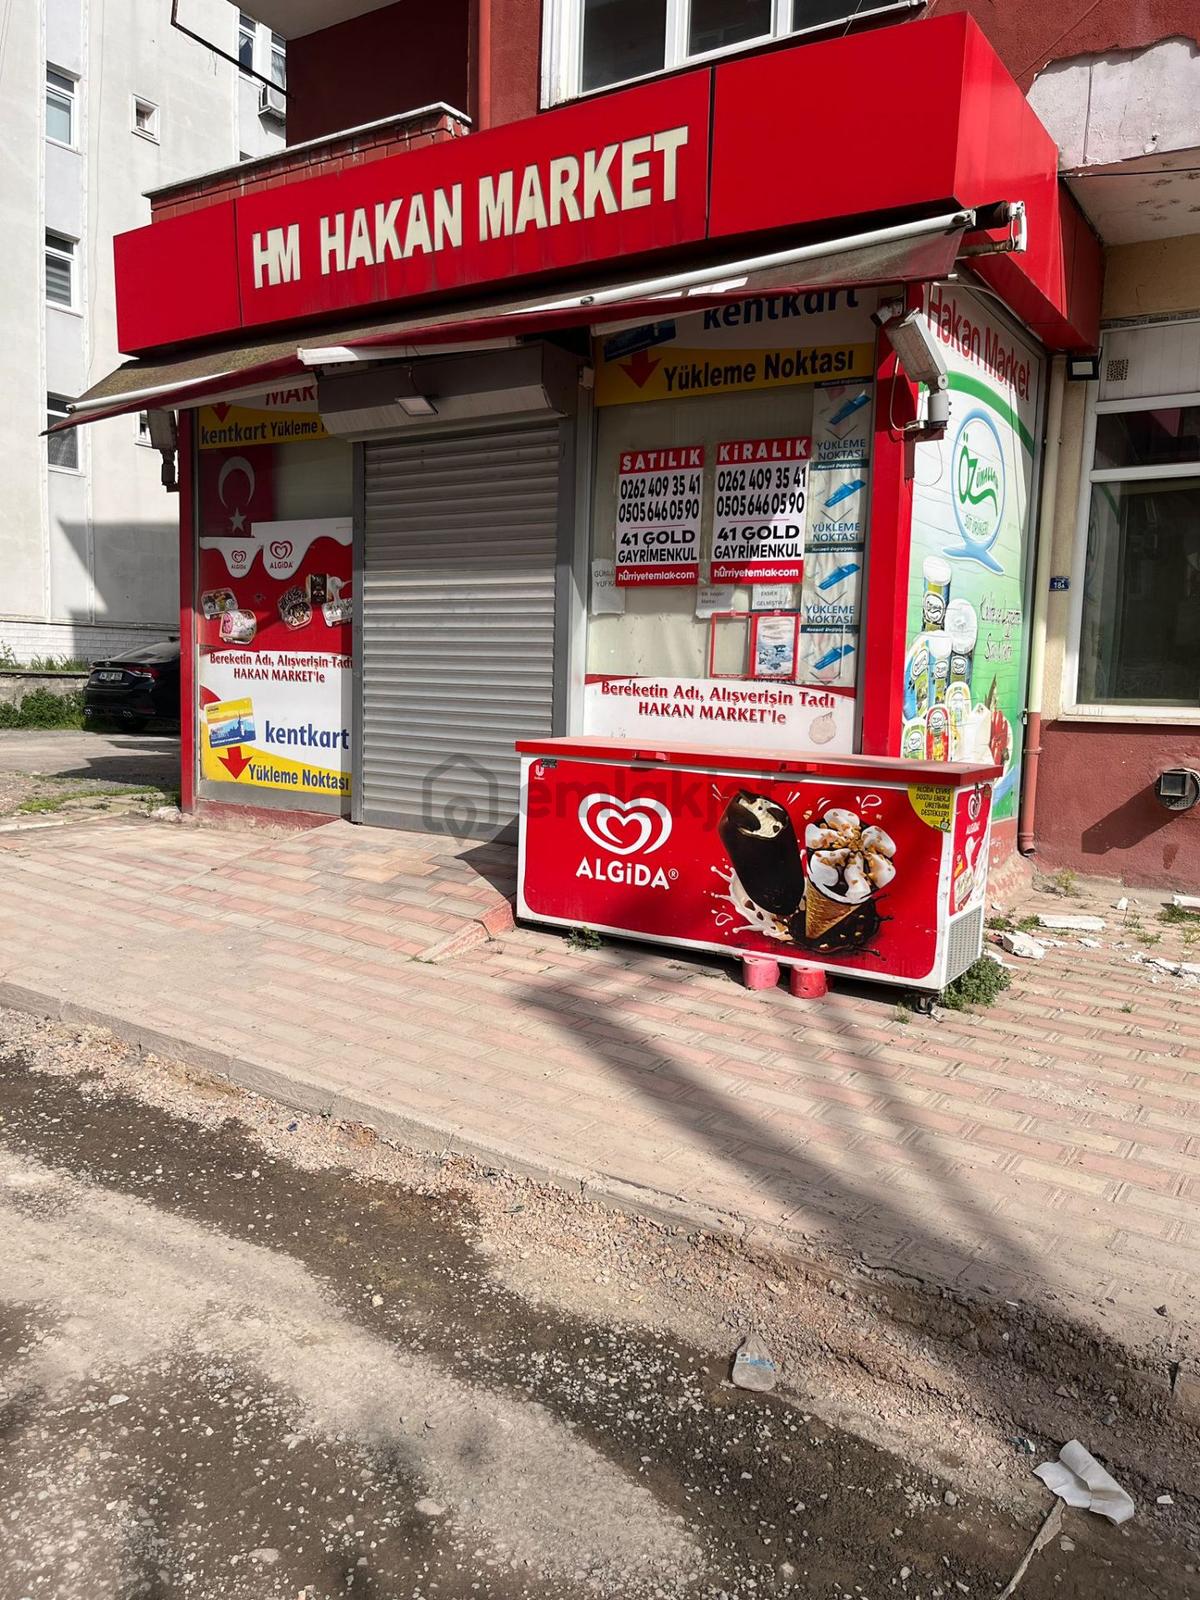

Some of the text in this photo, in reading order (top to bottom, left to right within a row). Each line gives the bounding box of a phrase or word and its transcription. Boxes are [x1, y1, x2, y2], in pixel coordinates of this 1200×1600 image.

[252, 126, 688, 288] HM HAKAN MARKET
[928, 285, 1030, 401] Hakan Market
[664, 350, 854, 392] Yükleme Noktası
[201, 422, 267, 445] kentkart
[271, 420, 318, 437] Yükleme
[816, 439, 866, 451] YÜKLEME
[818, 450, 864, 461] NOKTASI
[622, 448, 701, 471] SATILIK
[620, 474, 700, 500] 0262 409 35 41
[717, 466, 806, 493] 0262 409 35 41
[618, 501, 646, 523] 0505
[648, 500, 667, 521] 646
[716, 495, 746, 517] 0505
[747, 494, 769, 515] 646
[621, 529, 696, 547] 41 GOLD
[717, 524, 800, 540] 41 GOLD
[812, 522, 860, 532] YÜKLEME
[813, 533, 859, 542] NOKTASI
[805, 605, 855, 615] YÜKLEME
[807, 615, 853, 624] NOKTASI
[210, 653, 252, 665] Bereketin
[233, 668, 325, 683] HAKAN MARKET'le
[601, 680, 668, 698] Bereketin
[799, 692, 835, 708] Tadı
[639, 702, 786, 725] HAKAN MARKET'le
[265, 720, 349, 749] kentkart
[249, 764, 349, 791] Yükleme Noktası
